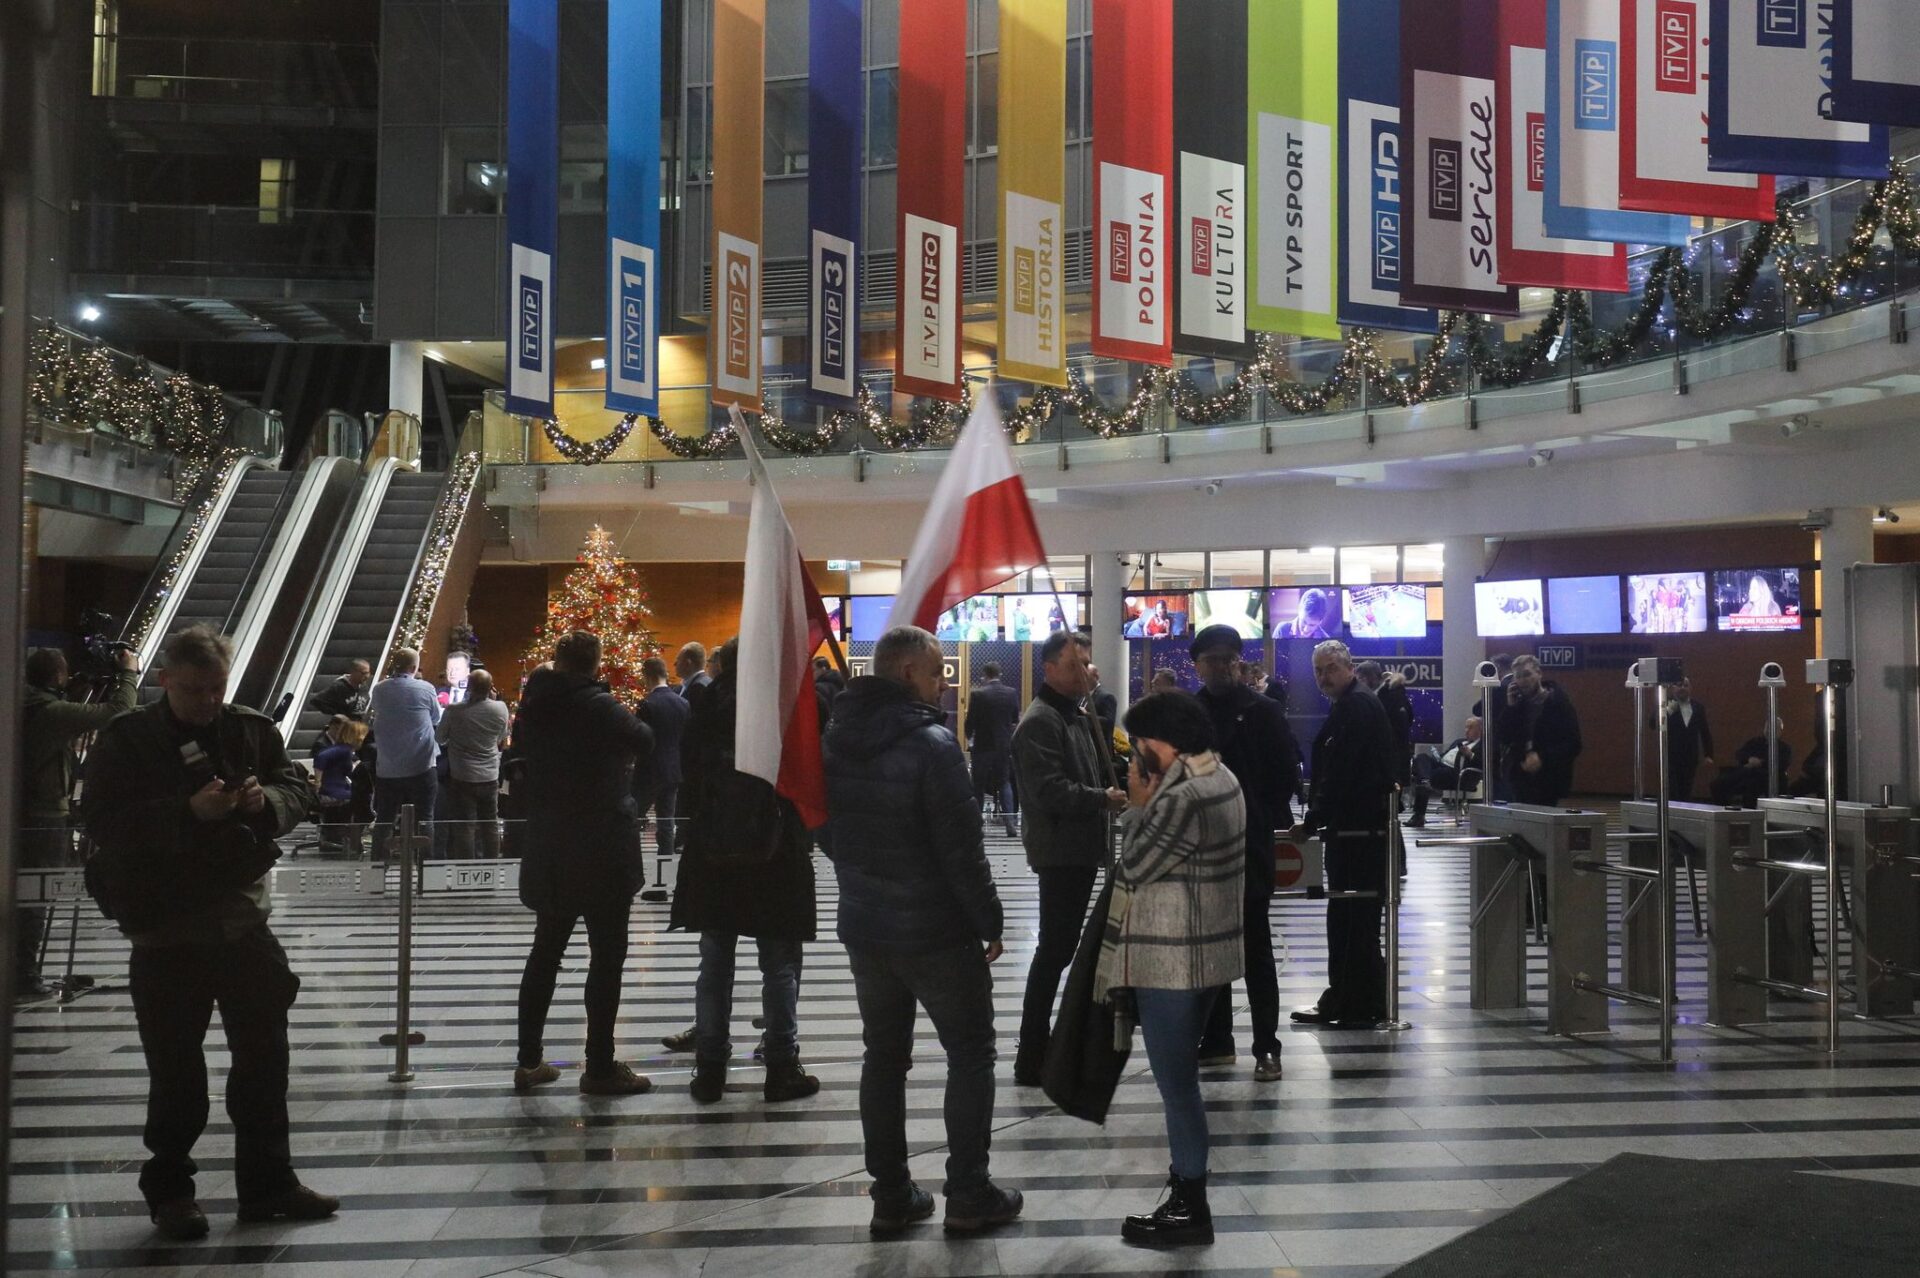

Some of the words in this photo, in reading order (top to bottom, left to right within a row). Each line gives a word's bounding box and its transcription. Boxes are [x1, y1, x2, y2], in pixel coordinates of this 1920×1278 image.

[1665, 15, 1687, 78] TVP
[1584, 55, 1606, 117] TVP
[1286, 132, 1303, 229] SPORT
[1374, 131, 1400, 203] HD
[1436, 152, 1455, 208] TVP
[1469, 95, 1493, 275] seriale
[729, 260, 748, 289] 2
[825, 259, 843, 287] 3
[924, 236, 938, 299] INFO
[1114, 231, 1127, 272] TVP
[1138, 191, 1154, 325] POLONIA
[1196, 226, 1208, 268] TVP
[1216, 188, 1234, 315] KULTURA
[1286, 234, 1303, 294] TVP
[1379, 215, 1397, 276] TVP
[623, 271, 642, 289] 1
[1017, 255, 1031, 306] TVP
[1038, 216, 1053, 352] HISTORIA
[524, 292, 538, 359] TVP
[625, 301, 640, 365] TVP
[731, 296, 745, 363] TVP
[826, 295, 841, 363] TVP
[923, 304, 938, 363] TVP
[1385, 662, 1441, 684] WORL
[1541, 649, 1573, 664] TVP
[459, 871, 493, 884] TVP
